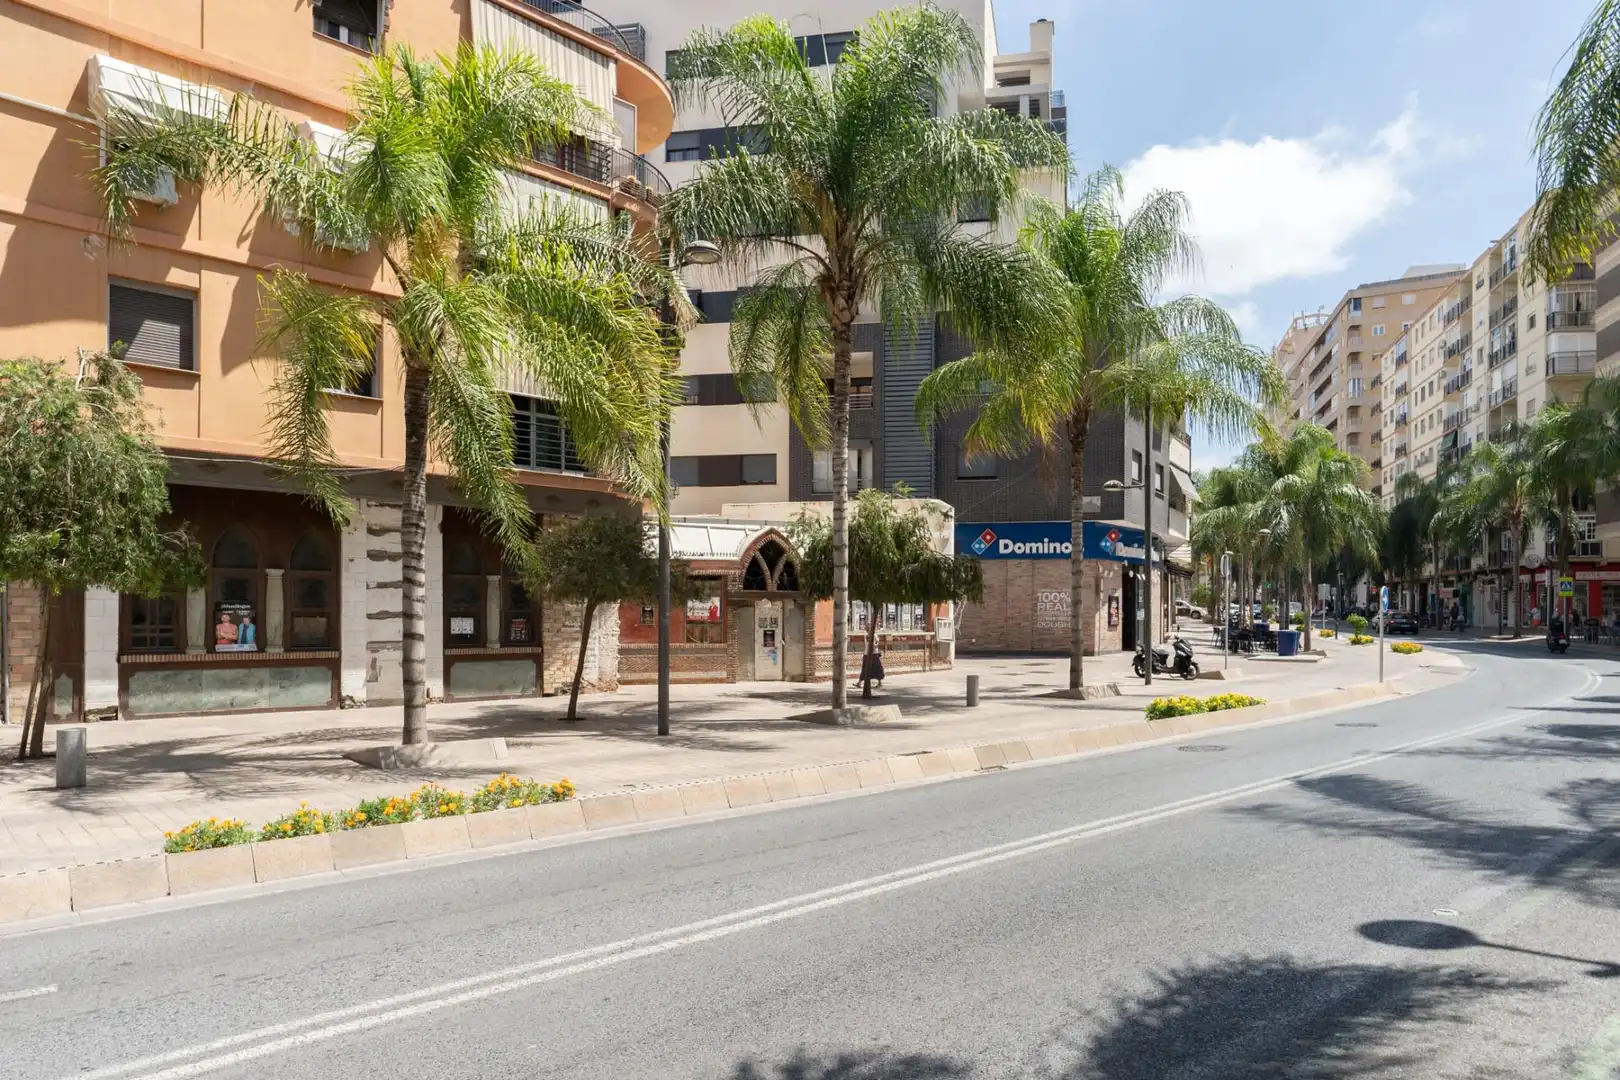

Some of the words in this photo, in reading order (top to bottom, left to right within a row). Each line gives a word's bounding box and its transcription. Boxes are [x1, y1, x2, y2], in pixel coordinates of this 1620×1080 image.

[999, 537, 1084, 554] Domino
[1037, 592, 1071, 602] 100%
[1038, 602, 1072, 611] REAL
